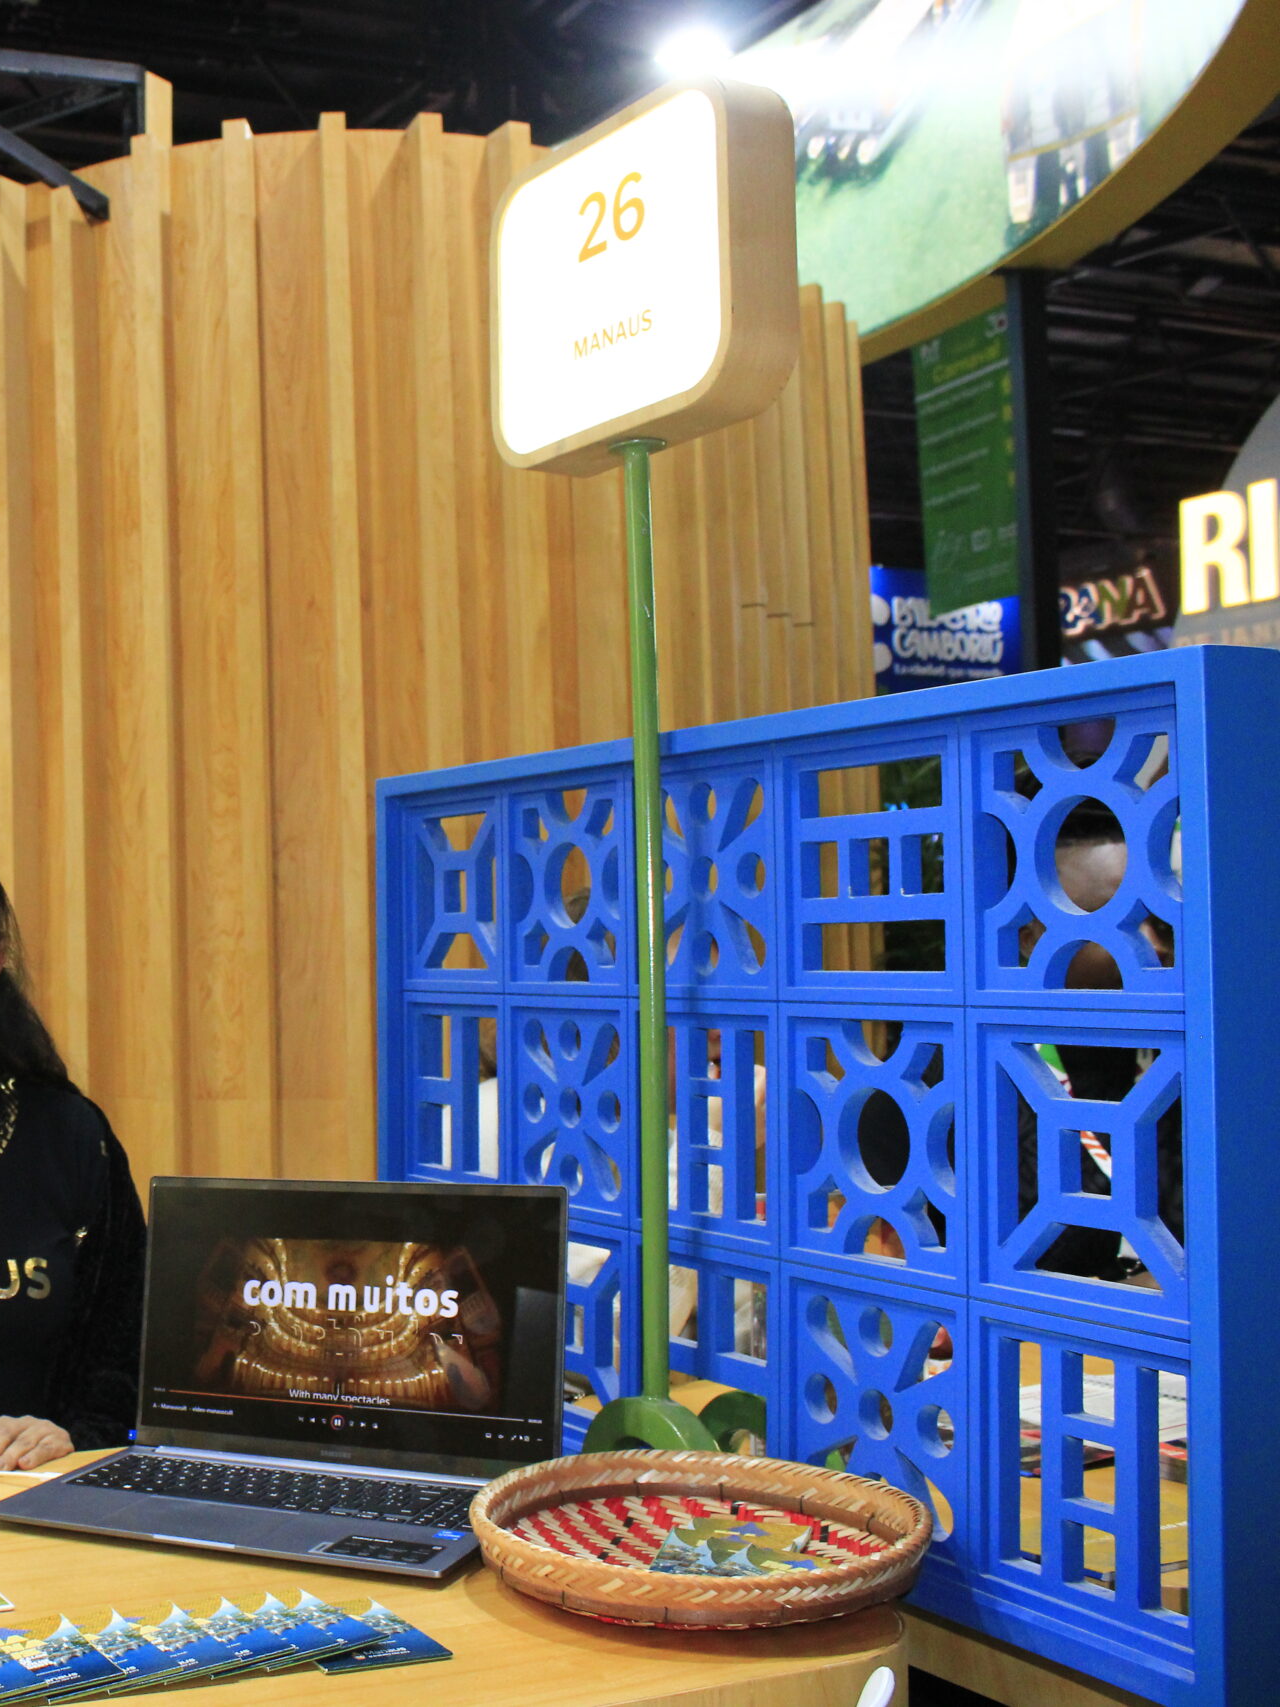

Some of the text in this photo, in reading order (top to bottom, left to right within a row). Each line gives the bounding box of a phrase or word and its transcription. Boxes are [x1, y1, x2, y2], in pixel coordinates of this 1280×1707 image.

[578, 171, 645, 263] 26
[573, 308, 652, 360] MANAUS
[243, 1275, 459, 1318] com muitos
[289, 1389, 391, 1406] With many spectacles
